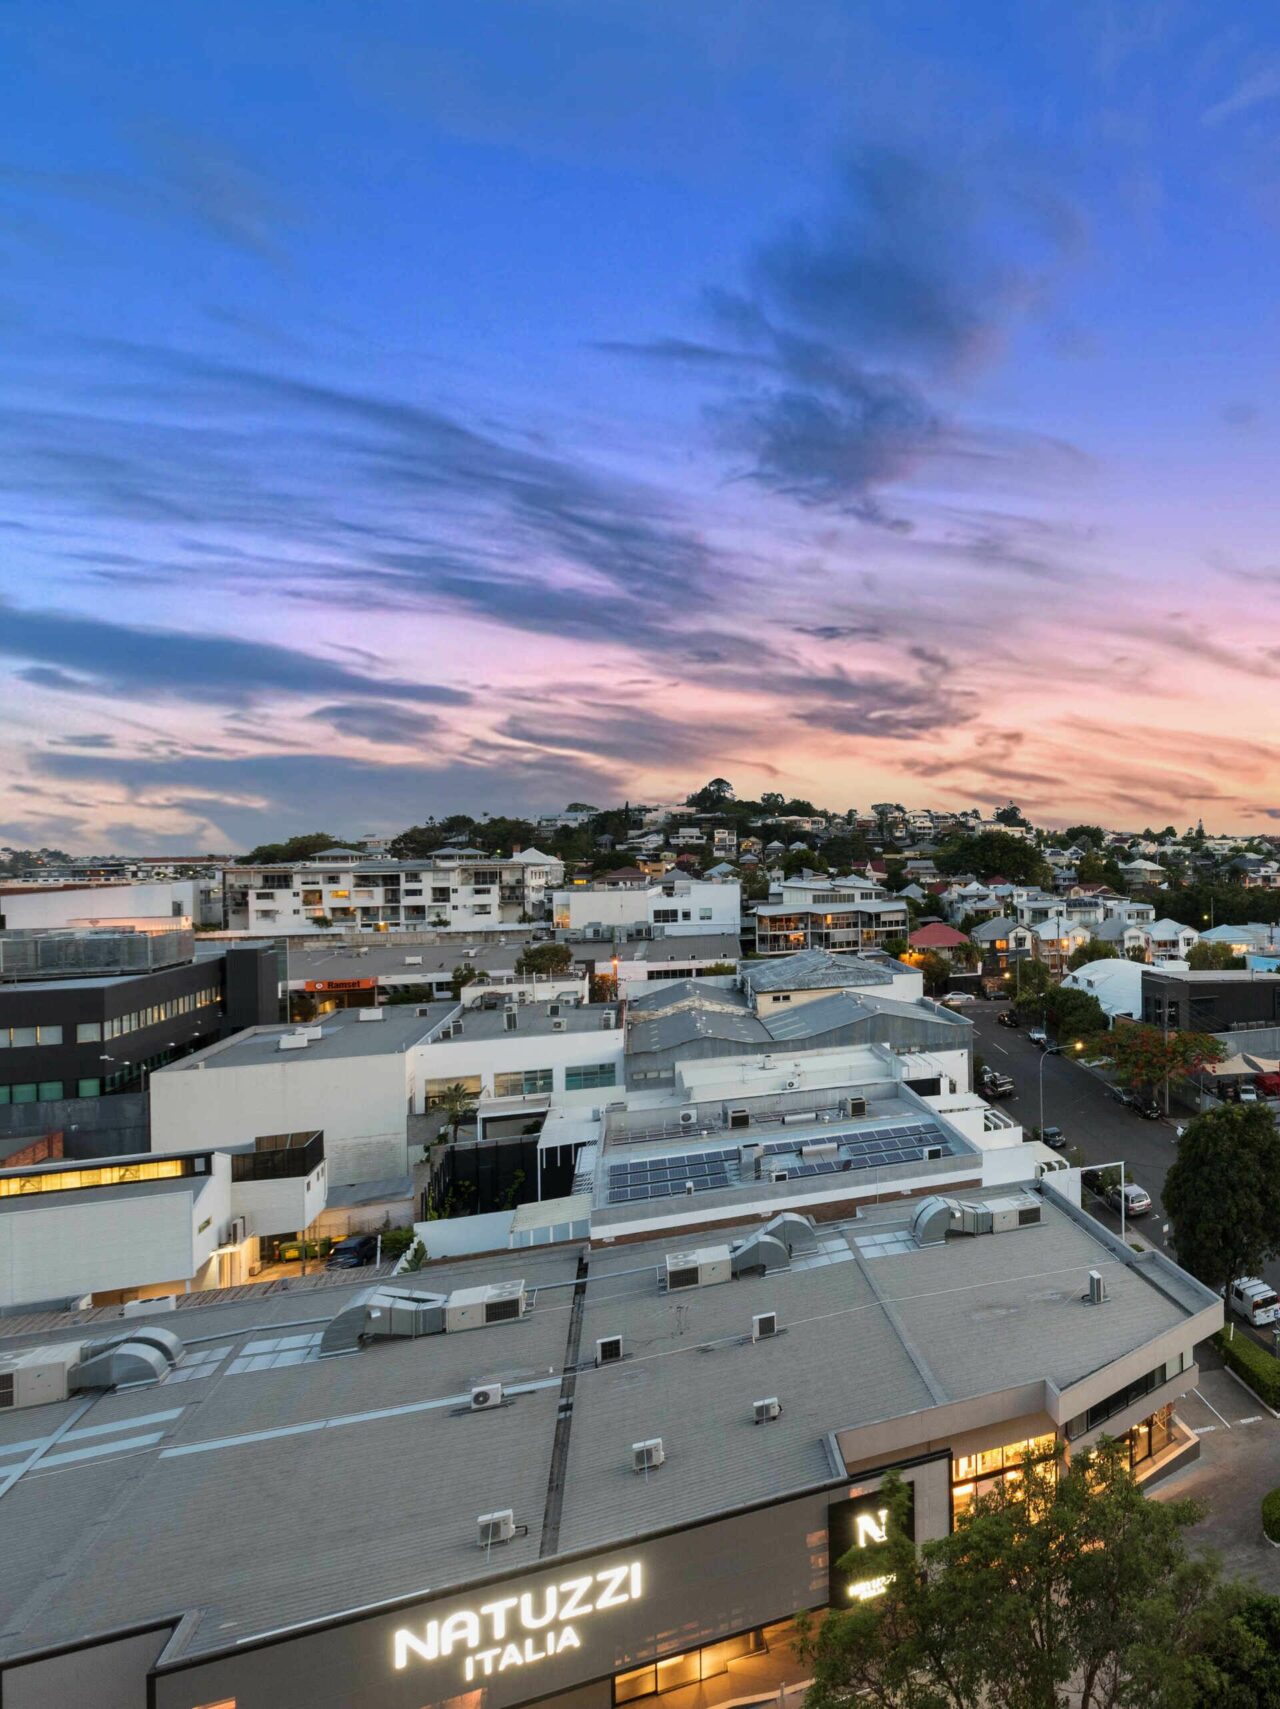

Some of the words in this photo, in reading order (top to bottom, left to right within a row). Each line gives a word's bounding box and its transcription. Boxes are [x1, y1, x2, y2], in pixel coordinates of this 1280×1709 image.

[327, 981, 361, 989] Ramset
[856, 1508, 889, 1548] N
[394, 1562, 642, 1669] NATUZZI
[464, 1625, 581, 1681] ITALIA
